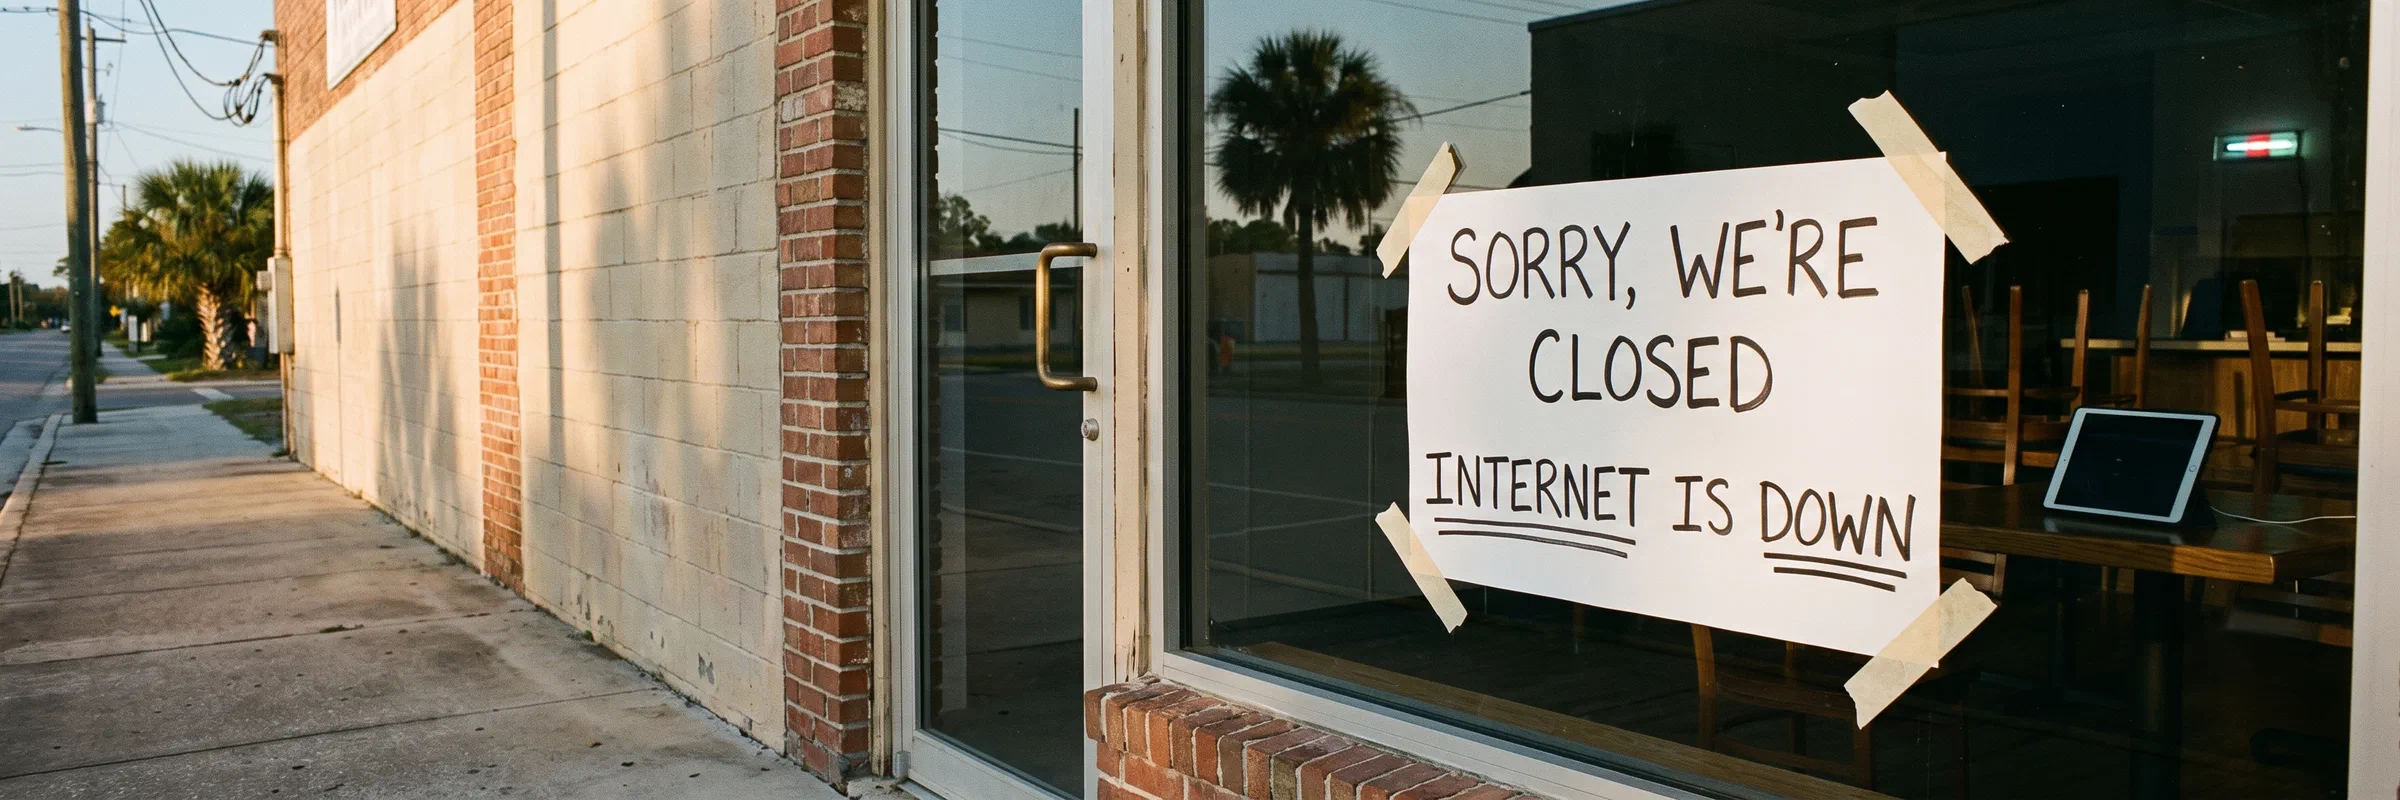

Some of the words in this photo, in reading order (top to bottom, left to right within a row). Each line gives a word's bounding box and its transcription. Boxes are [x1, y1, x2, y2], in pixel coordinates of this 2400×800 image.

[1448, 224, 1636, 311] SORRY,
[1669, 208, 1879, 301] WE'RE
[1528, 328, 1774, 414] CLOSED
[1425, 451, 1651, 528] INTERNET
[1672, 475, 1734, 536] IS
[1759, 480, 1917, 562] DOWN
